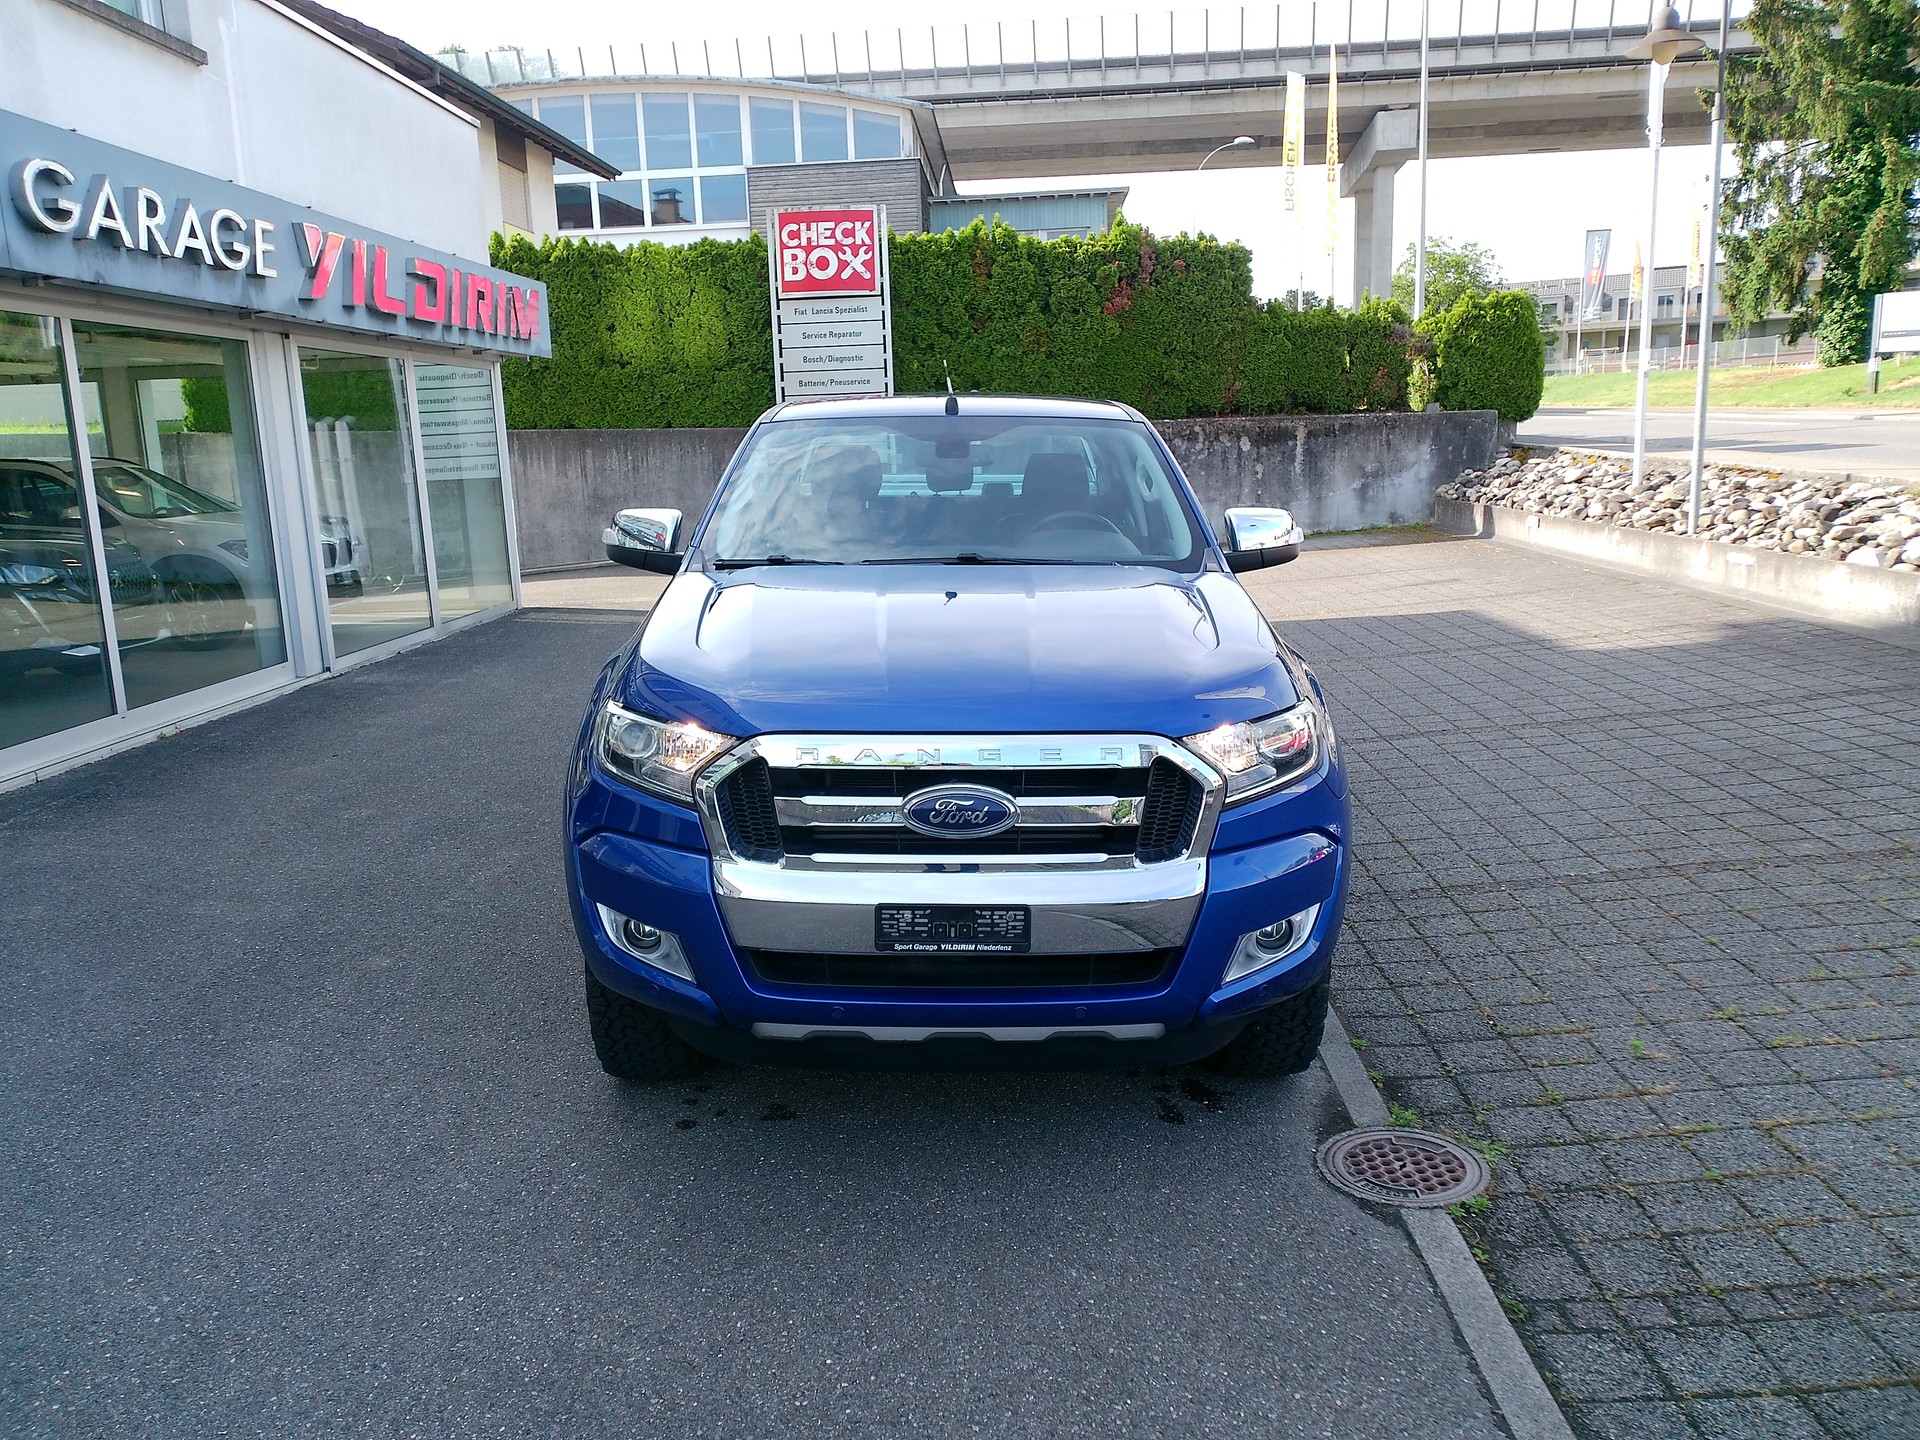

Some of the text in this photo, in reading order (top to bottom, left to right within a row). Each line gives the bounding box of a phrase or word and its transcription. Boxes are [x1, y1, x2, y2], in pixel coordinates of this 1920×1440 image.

[781, 221, 872, 247] CHECK
[9, 157, 539, 340] GARAGE YILDIRIM
[783, 246, 872, 282] BOX
[794, 306, 868, 316] Fiat Lancia Spezialist
[802, 331, 862, 340] Service Reparatur
[803, 354, 863, 364] Bosch/Diagnostic
[798, 378, 870, 388] Batterie/Pneuservice
[796, 747, 1123, 762] RANGER
[929, 799, 988, 825] Ford
[894, 943, 912, 951] Sport
[913, 943, 938, 951] Garage
